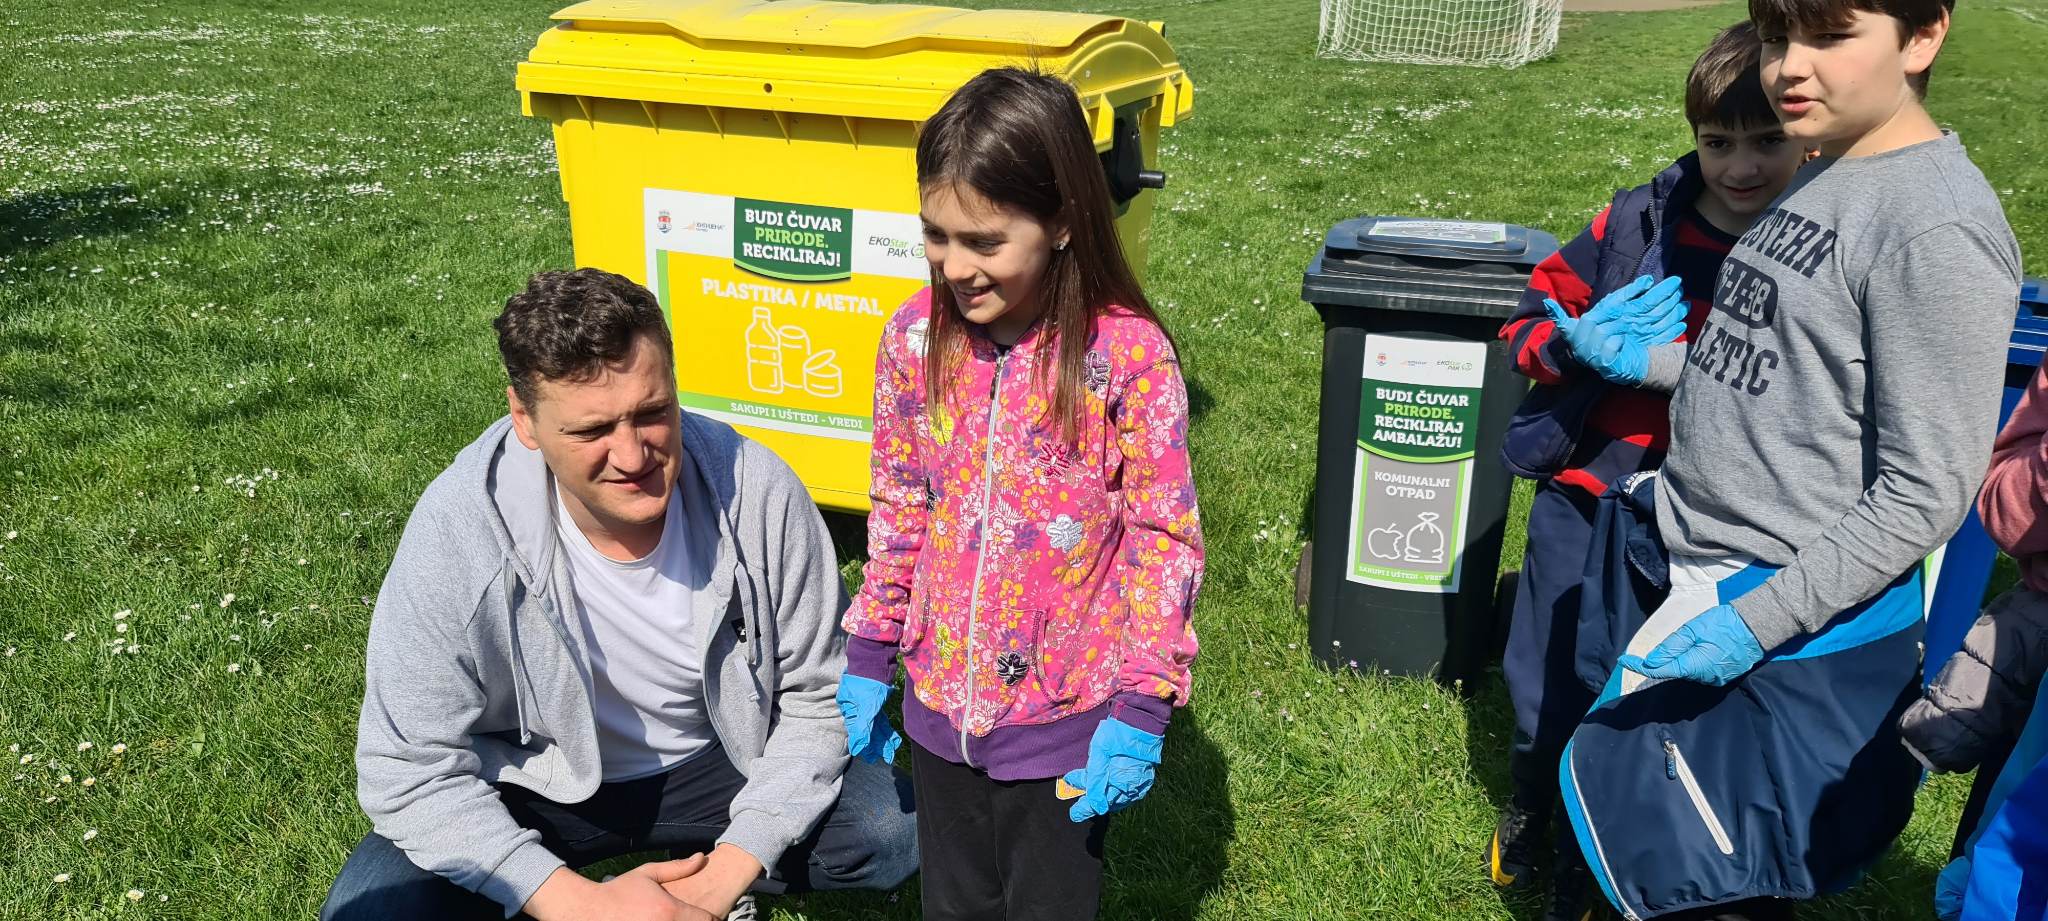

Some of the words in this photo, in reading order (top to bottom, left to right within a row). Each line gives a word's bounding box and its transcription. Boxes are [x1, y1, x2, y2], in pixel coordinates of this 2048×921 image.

[744, 208, 783, 226] BUDI
[787, 210, 842, 233] ČUVAR
[754, 227, 829, 248] PRIRODE.
[742, 243, 841, 267] RECIKLIRAJ!
[887, 248, 908, 258] PAK
[701, 278, 797, 306] PLASTIKA
[801, 290, 810, 308] /
[815, 292, 884, 316] METAL
[1375, 388, 1413, 403] BUDI
[1415, 389, 1469, 407] ČUVAR
[730, 402, 770, 417] SAKUPI
[772, 408, 777, 417] I
[778, 409, 819, 423] UŠTEDI
[828, 416, 863, 429] VREDI
[1384, 402, 1455, 420] PRIRODE.
[1374, 414, 1464, 434] RECIKLIRAJ
[1372, 429, 1462, 448] AMBALAŽU!
[1374, 471, 1451, 488] KOMUNALNI
[1385, 485, 1436, 500] OTPAD
